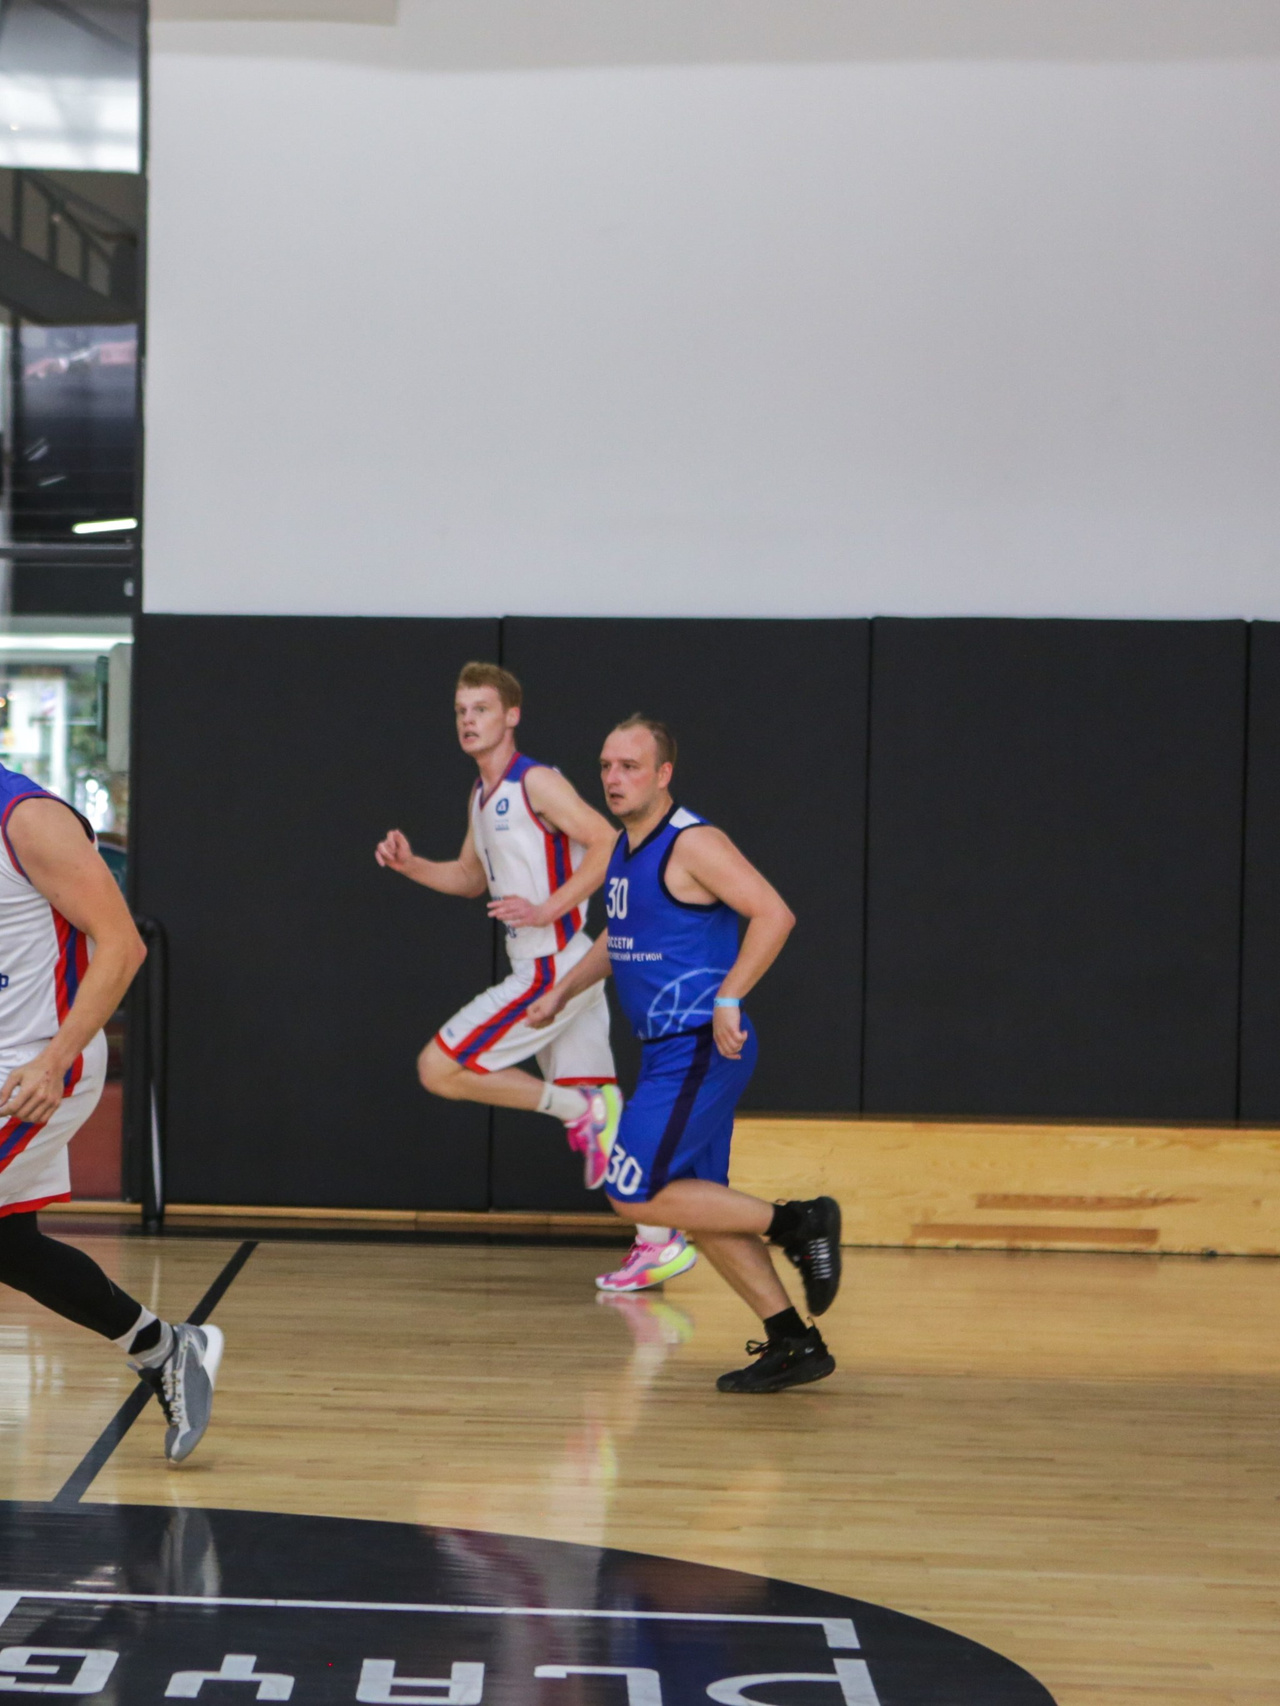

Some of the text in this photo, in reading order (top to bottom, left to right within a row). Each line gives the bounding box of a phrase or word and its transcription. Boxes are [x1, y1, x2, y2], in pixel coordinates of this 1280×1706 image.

[606, 876, 629, 920] 30
[632, 952, 663, 963] РЕГИОН
[605, 1144, 643, 1196] 30
